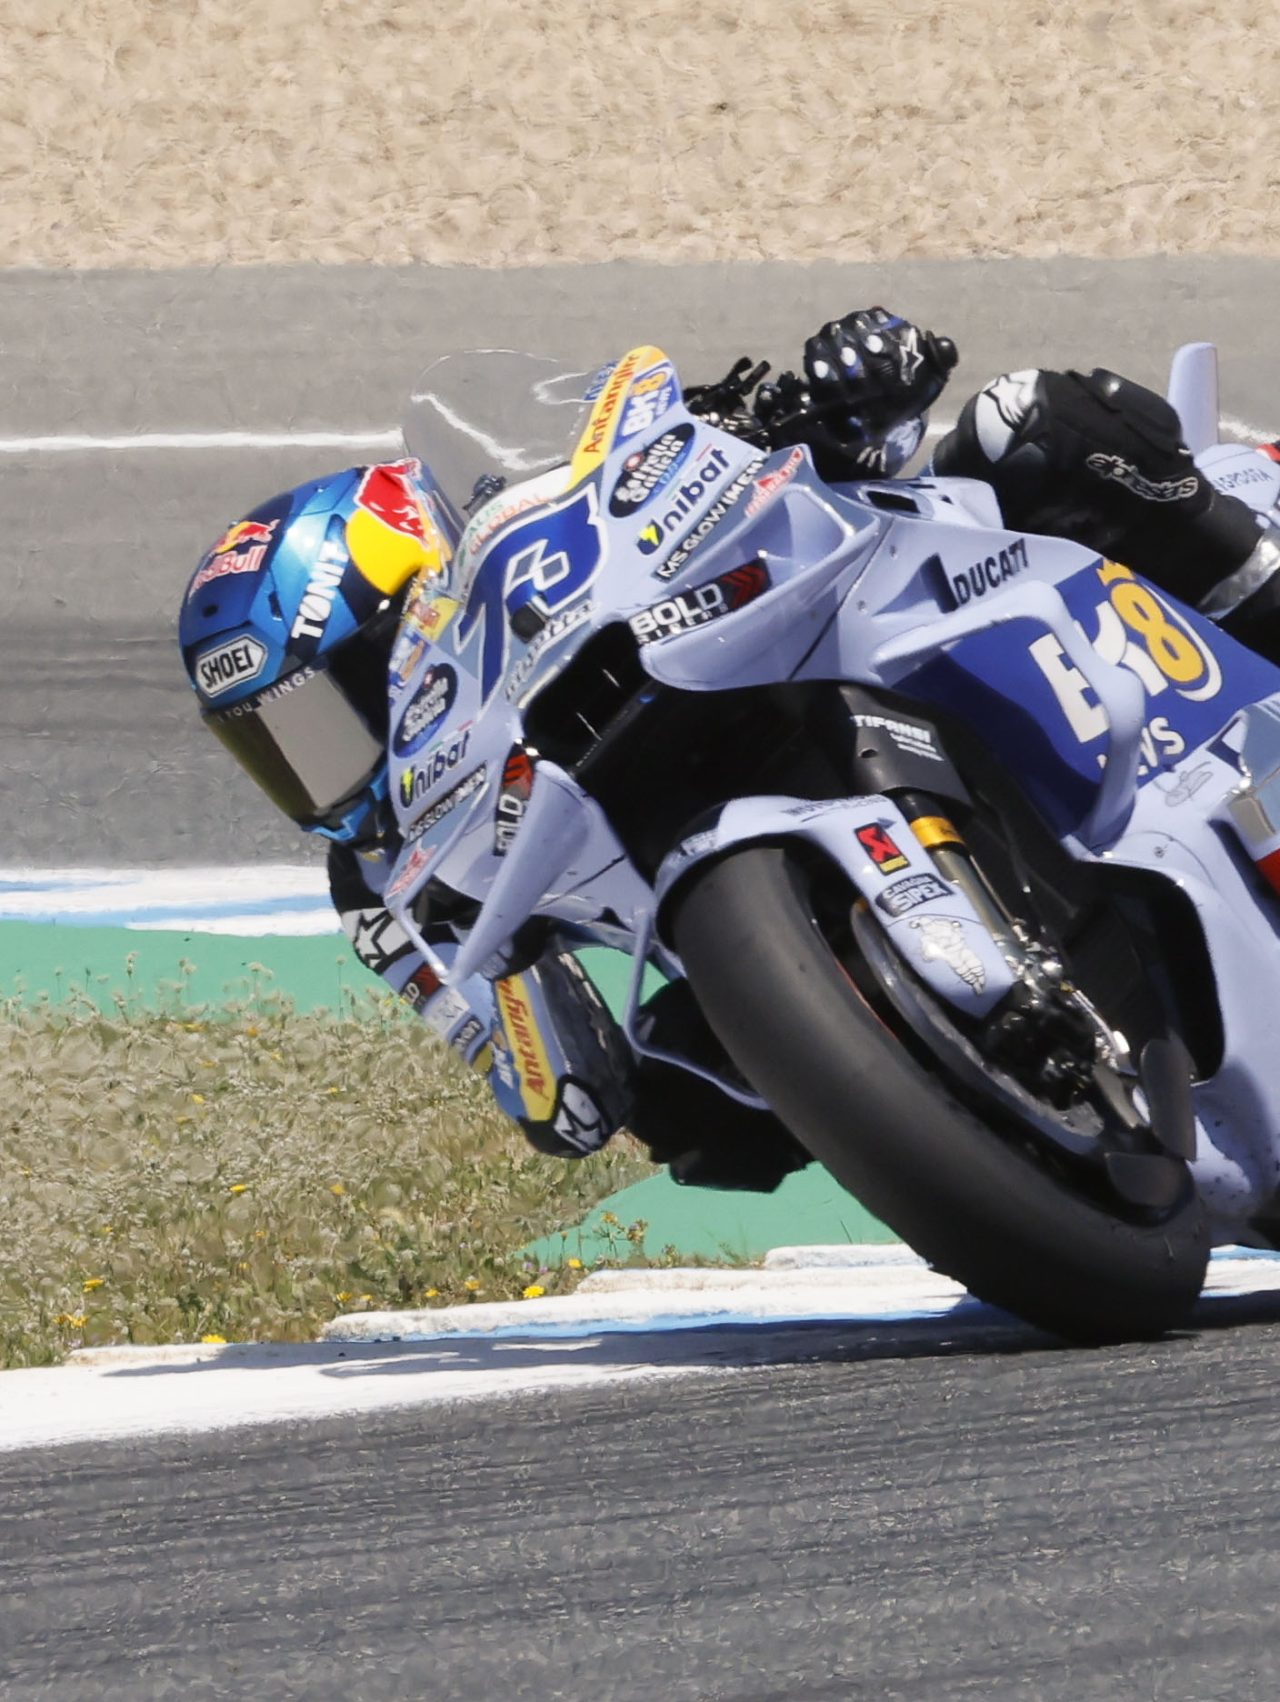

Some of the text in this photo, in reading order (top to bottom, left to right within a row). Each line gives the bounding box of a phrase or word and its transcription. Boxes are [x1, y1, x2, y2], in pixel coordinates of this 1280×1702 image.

[656, 551, 688, 578] MS
[682, 503, 727, 551] GLOW
[953, 538, 1030, 605] DUCATI
[629, 583, 724, 636] BOLD
[200, 645, 254, 690] SHOEI
